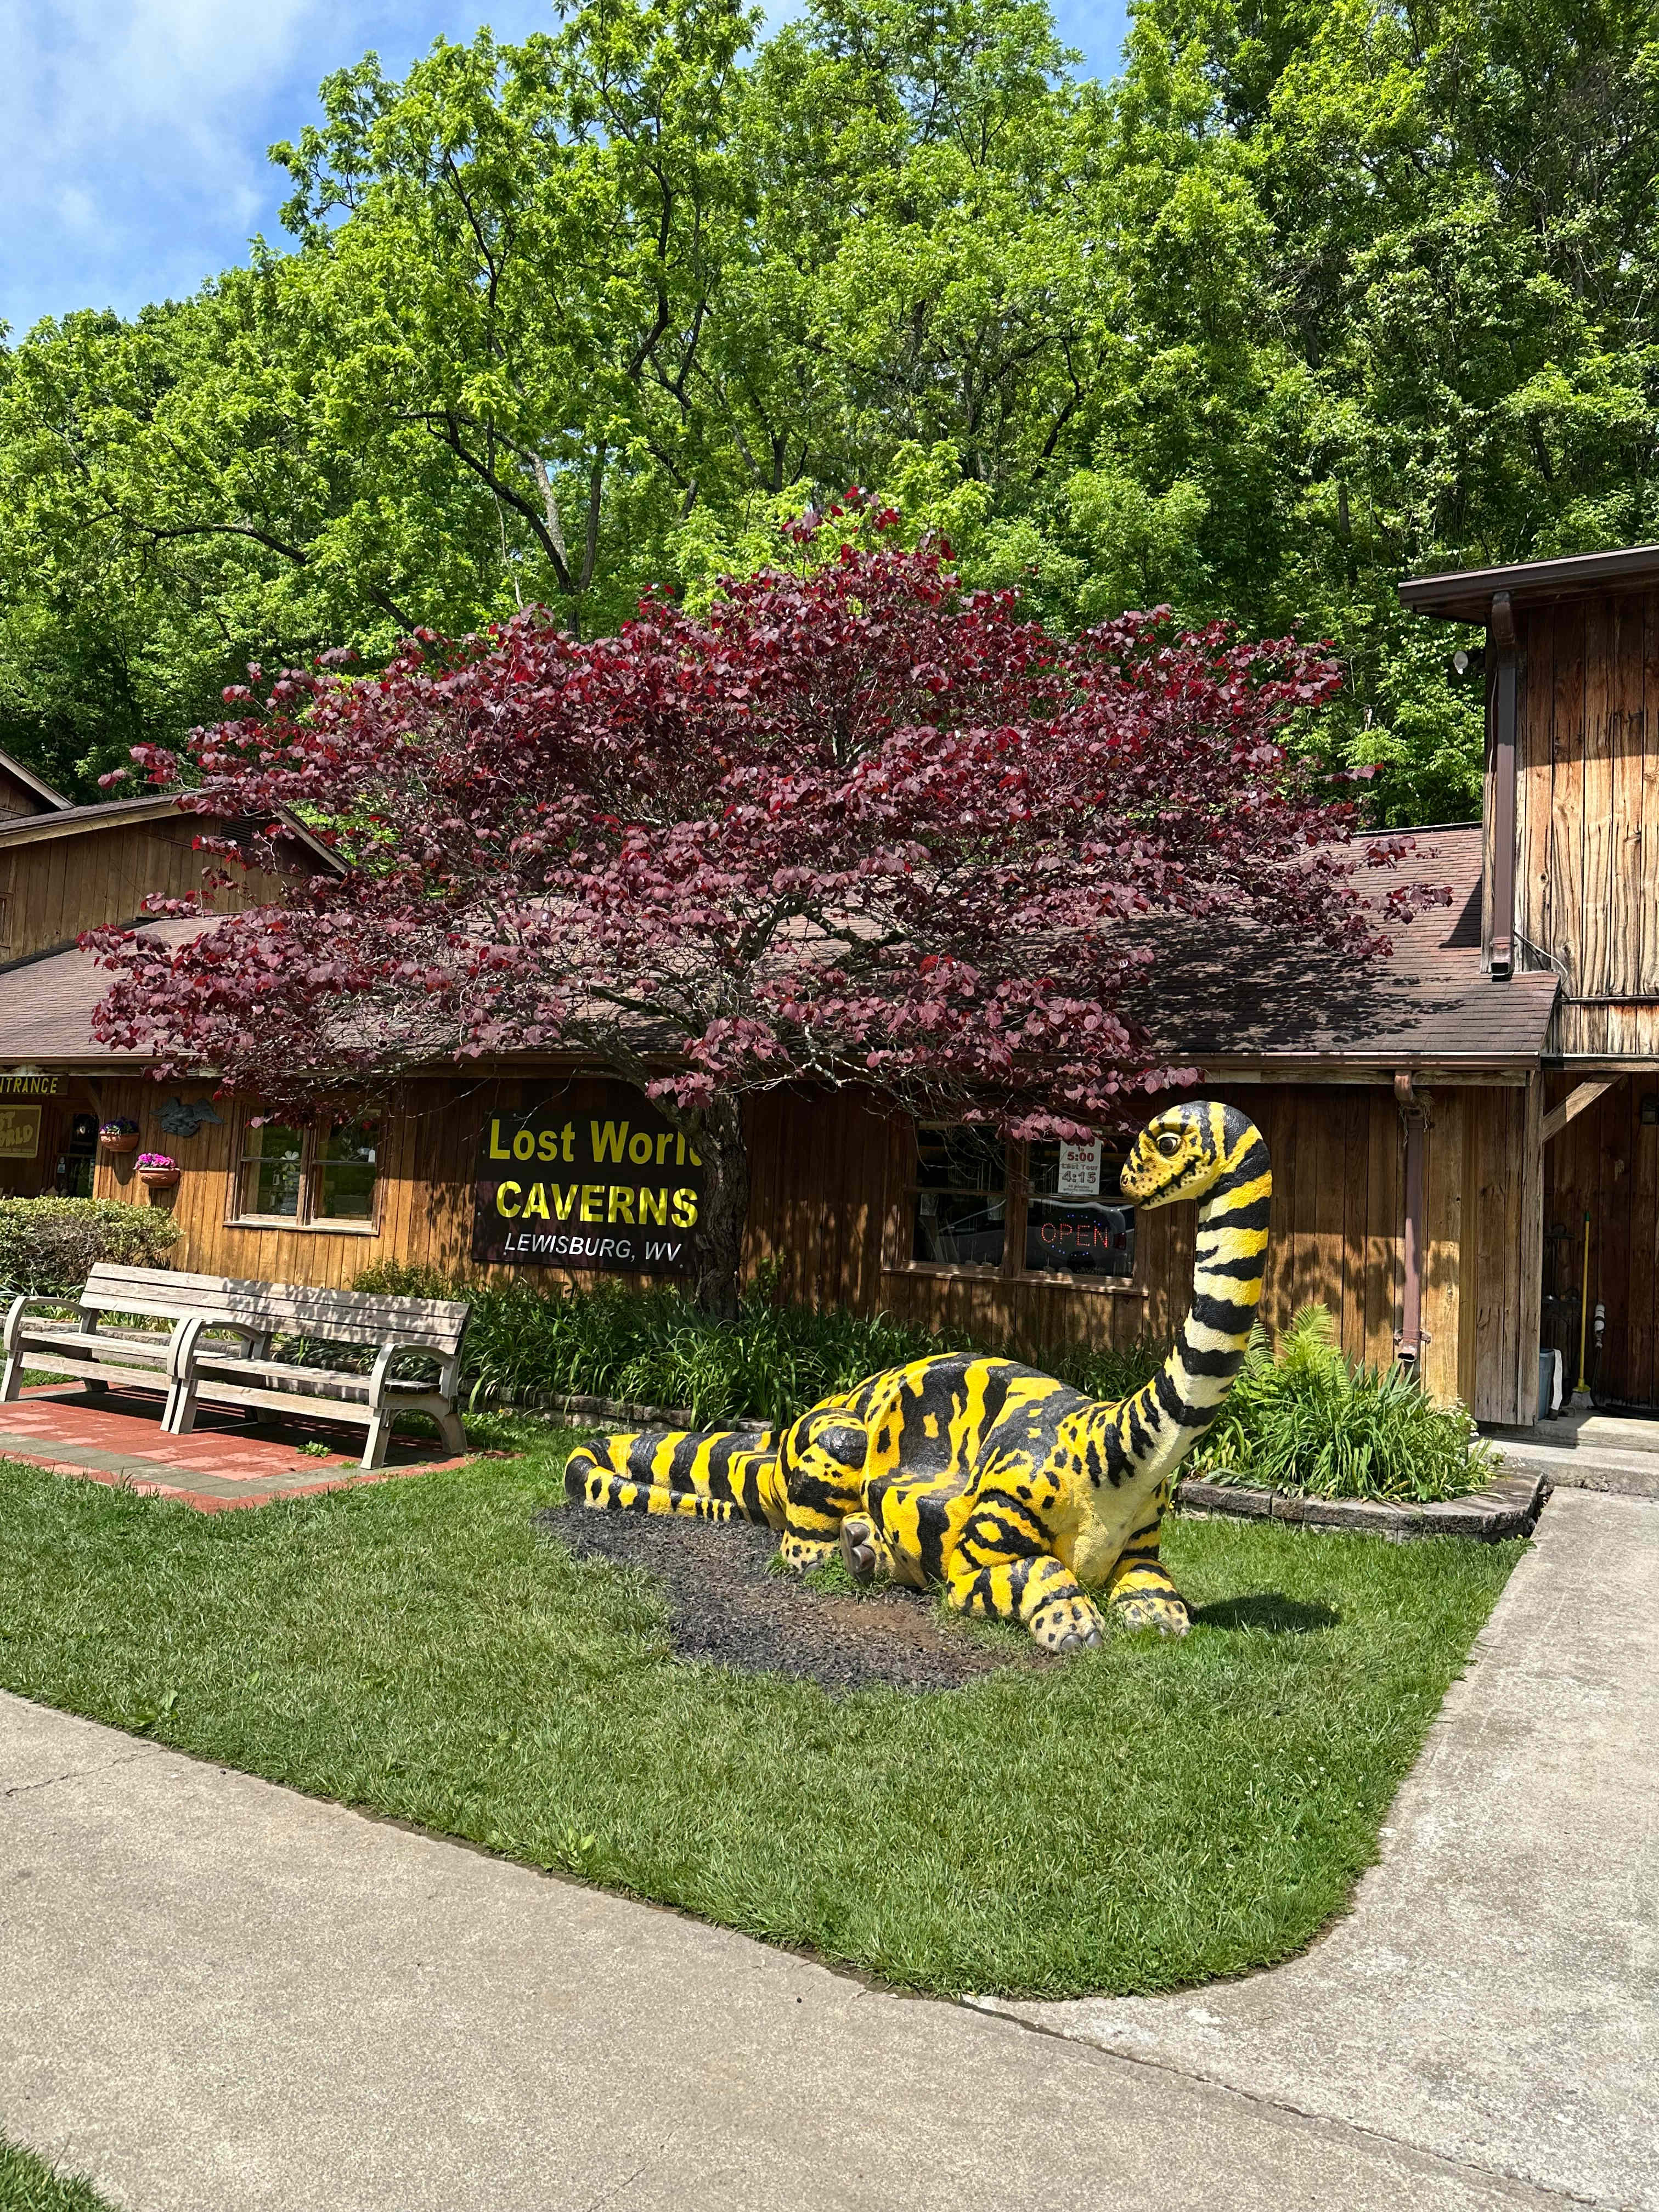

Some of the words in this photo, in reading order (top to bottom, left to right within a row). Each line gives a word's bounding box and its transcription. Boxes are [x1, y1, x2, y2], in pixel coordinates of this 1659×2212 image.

[489, 1119, 575, 1162] Lost
[590, 1121, 703, 1166] Worl
[1067, 1151, 1094, 1162] 5:00
[1062, 1171, 1096, 1184] 4:15
[496, 1181, 698, 1228] CAVERNS
[504, 1233, 635, 1262] LEWISBURG,
[645, 1242, 682, 1261] WV
[1041, 1223, 1109, 1248] OPEN
